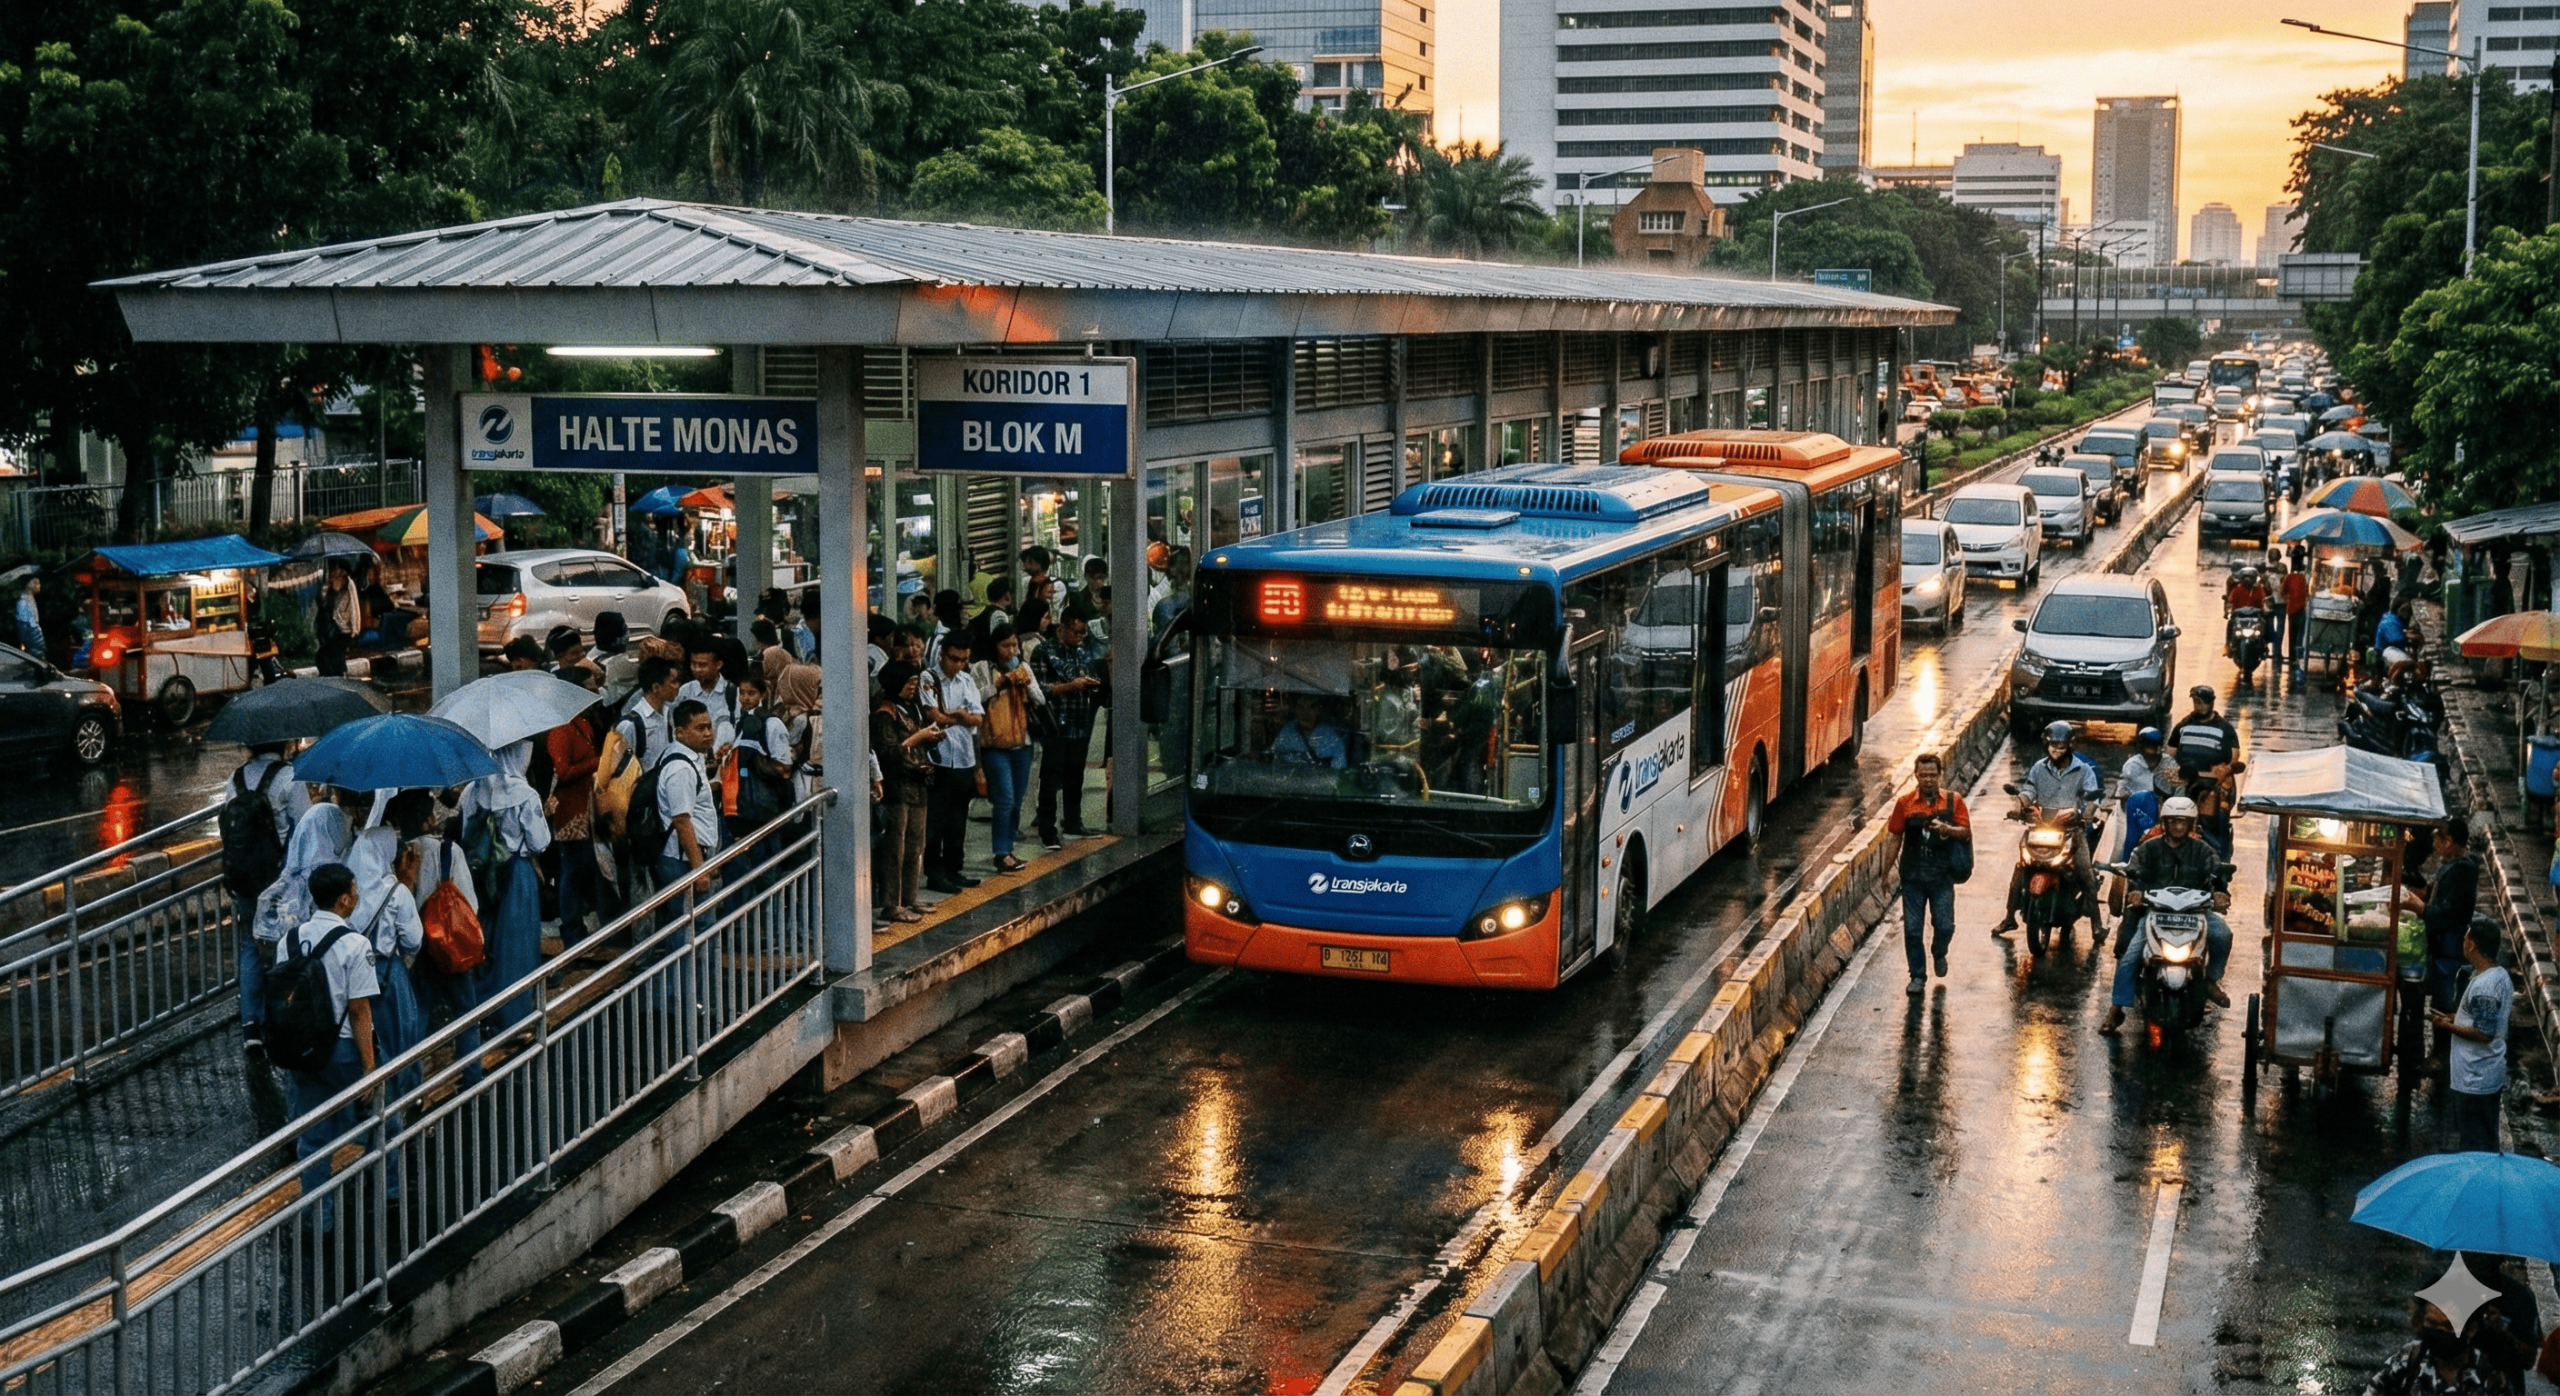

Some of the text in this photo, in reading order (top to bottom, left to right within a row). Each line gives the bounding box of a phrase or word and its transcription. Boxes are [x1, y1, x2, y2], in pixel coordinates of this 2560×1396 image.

[963, 368, 1089, 396] KORIDOR 1
[559, 415, 798, 455] HALTE MONAS
[962, 420, 1082, 455] BLOK M
[1634, 731, 1685, 799] transjakarta
[1330, 876, 1408, 894] transjakarta
